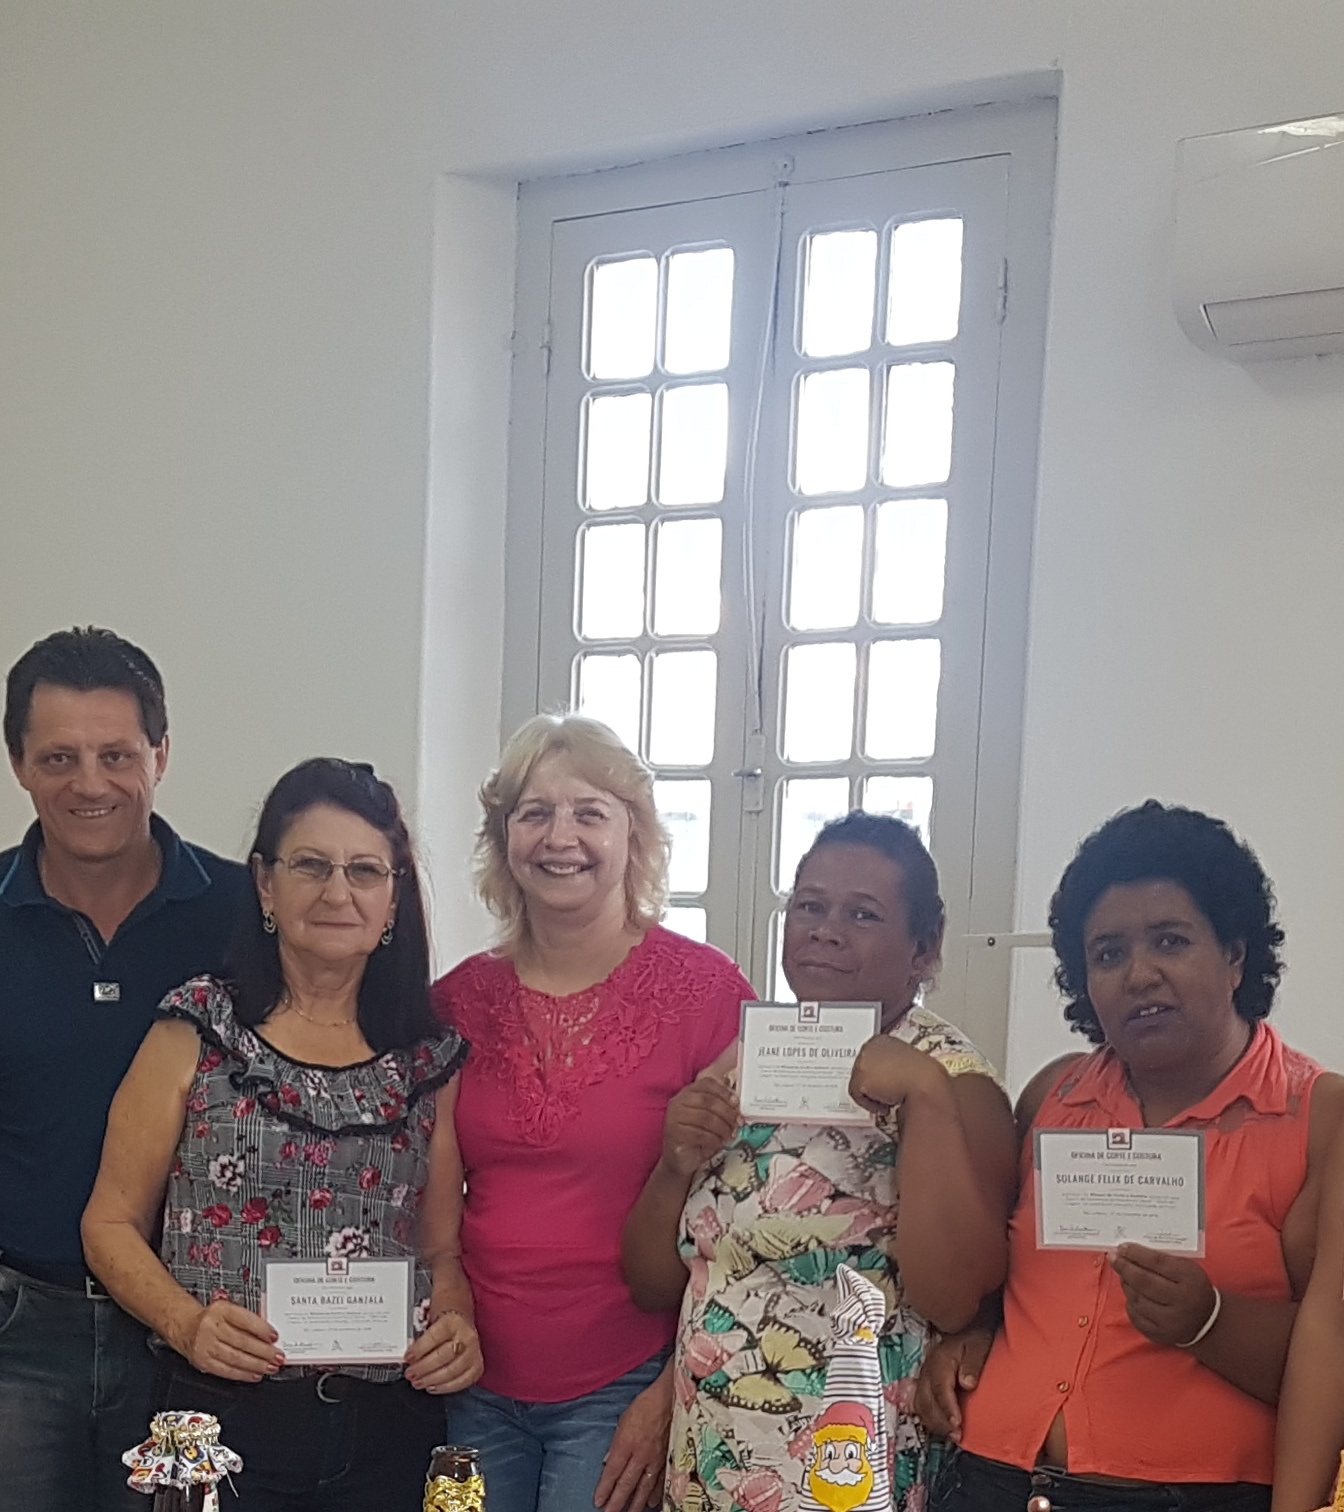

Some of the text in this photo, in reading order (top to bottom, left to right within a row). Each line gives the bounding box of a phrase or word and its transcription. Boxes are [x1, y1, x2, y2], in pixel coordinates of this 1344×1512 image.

[783, 1048, 806, 1057] LOPES
[809, 1048, 818, 1057] DE
[822, 1048, 857, 1057] OLIVEIRA
[1056, 1174, 1184, 1186] SOLANGE FELIX DE CARVALHO
[291, 1296, 318, 1305] SANTA
